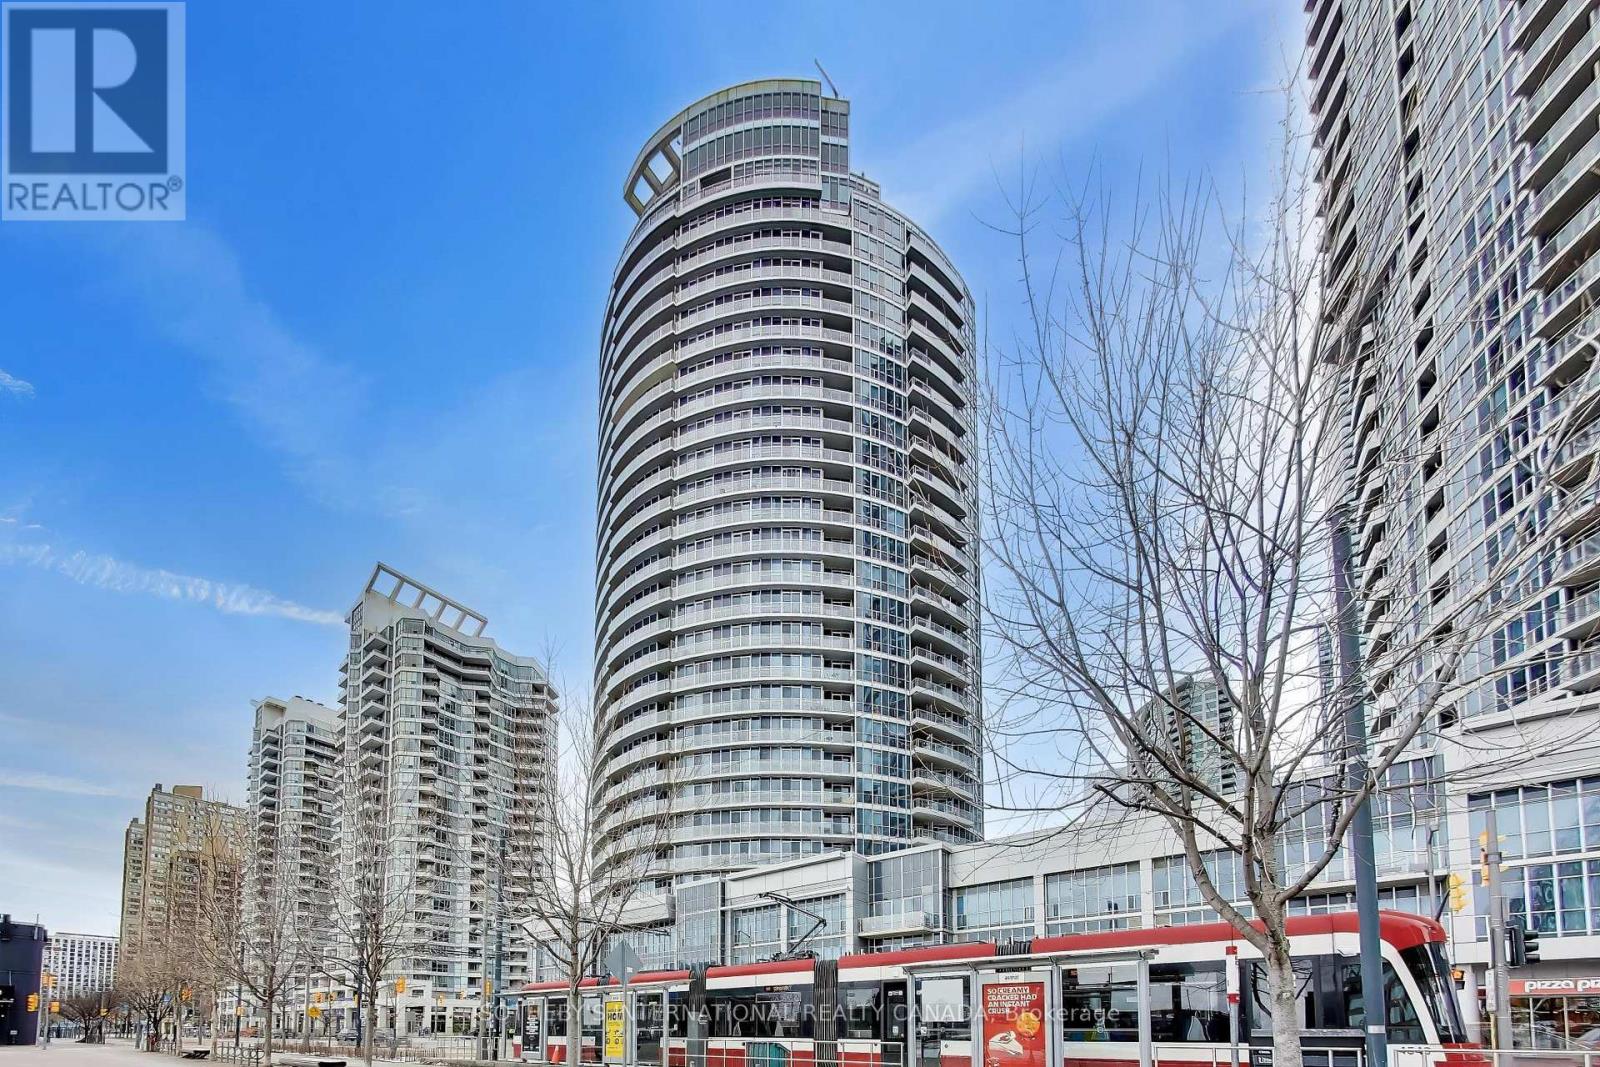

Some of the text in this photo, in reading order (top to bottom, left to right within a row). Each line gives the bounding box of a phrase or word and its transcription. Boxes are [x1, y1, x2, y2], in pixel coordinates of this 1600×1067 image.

[997, 986, 1029, 994] CREAMY
[1525, 980, 1575, 993] pizza
[1000, 1000, 1030, 1008] INSTANT
